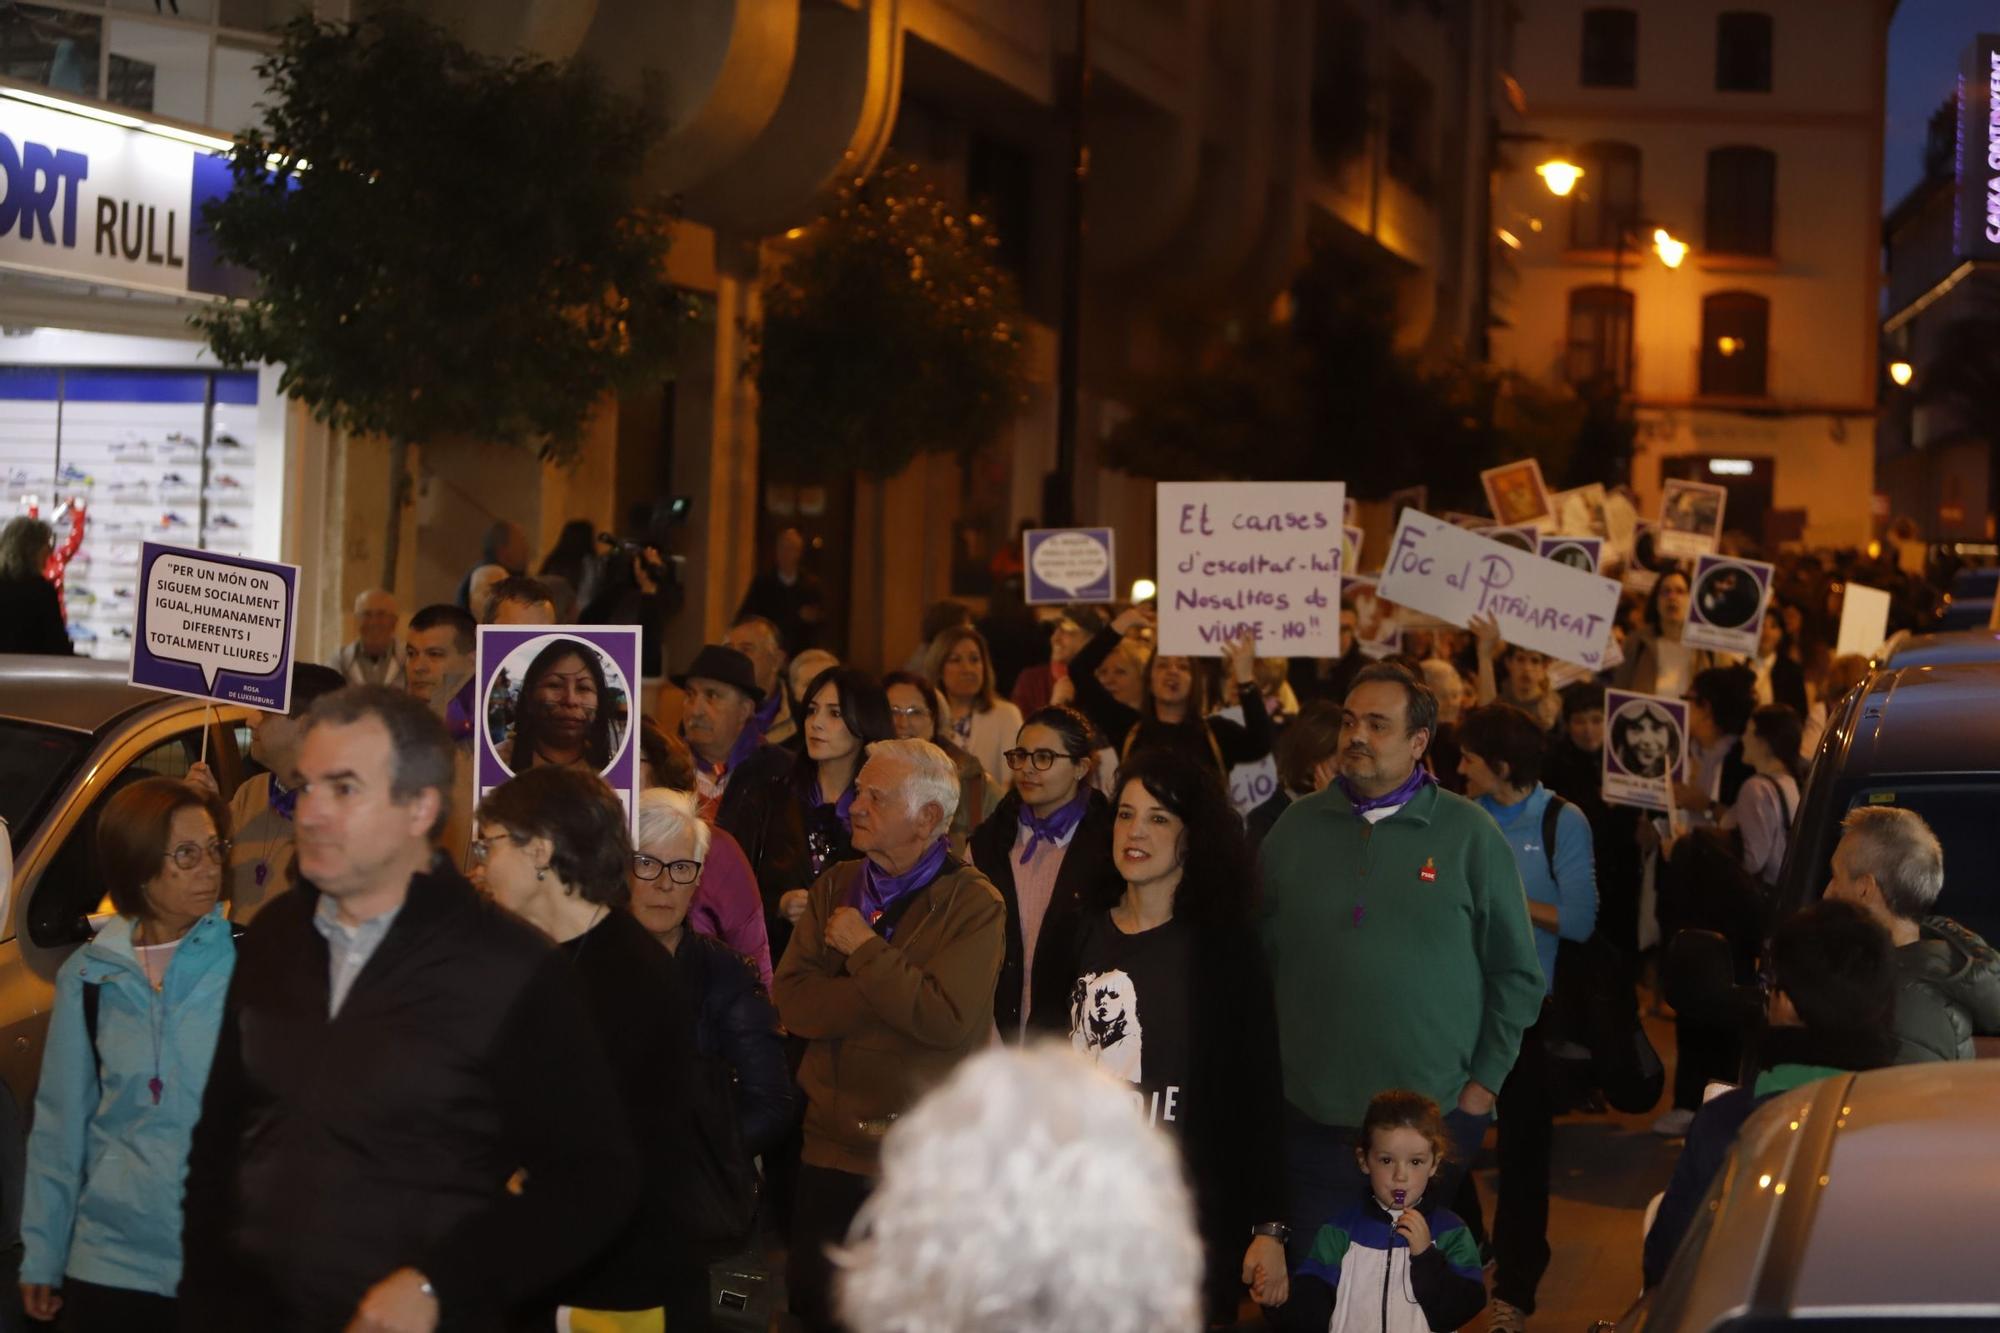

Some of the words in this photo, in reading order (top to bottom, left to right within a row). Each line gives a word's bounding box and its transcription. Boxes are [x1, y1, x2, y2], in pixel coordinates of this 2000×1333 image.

[95, 194, 183, 268] RULL
[1179, 502, 1214, 536] Et
[1232, 511, 1328, 531] canses
[197, 569, 215, 582] UN
[218, 571, 248, 587] MÓN
[250, 578, 269, 591] ON
[1446, 560, 1471, 592] al
[157, 579, 202, 598] SIGUEM
[204, 587, 280, 610] SOCIALMENT
[182, 619, 244, 640] DIFERENTS
[246, 631, 251, 642] I
[150, 631, 220, 654] TOTALMENT
[223, 645, 269, 663] LLIURES
[228, 690, 237, 699] DE
[237, 692, 275, 706] LUXEMBURG
[243, 684, 260, 694] ROSA
